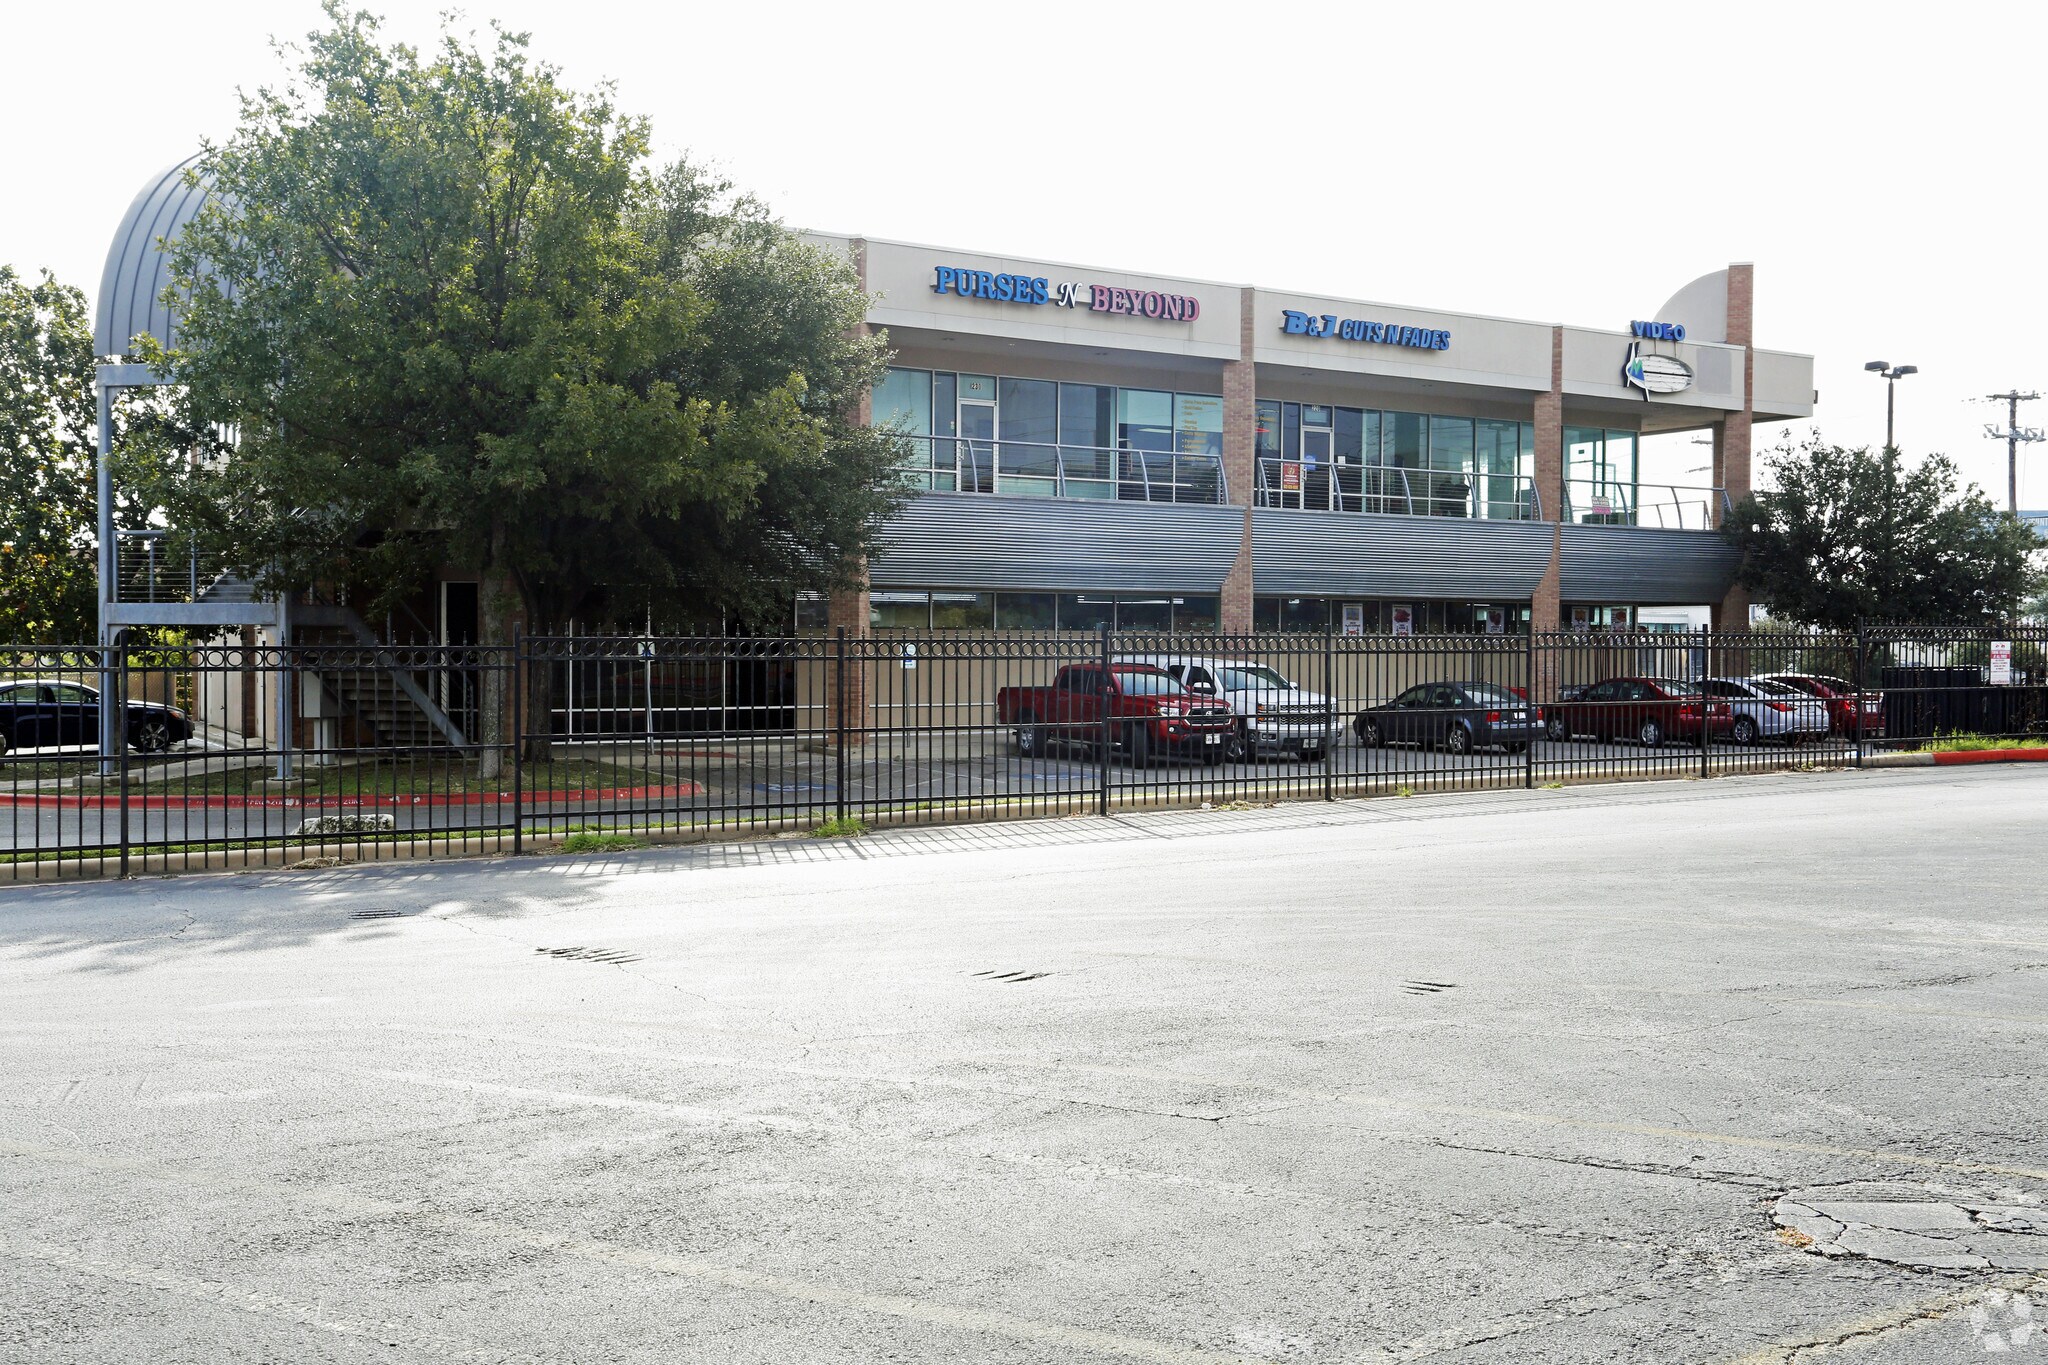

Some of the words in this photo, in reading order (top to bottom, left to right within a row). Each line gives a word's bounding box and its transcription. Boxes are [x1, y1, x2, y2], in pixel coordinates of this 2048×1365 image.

[935, 266, 1049, 305] PURSES
[1056, 281, 1084, 308] N
[1089, 284, 1200, 322] BEYOND
[1281, 309, 1337, 339] B&J
[1340, 318, 1385, 344] CUTS
[1385, 323, 1401, 346] N
[1400, 324, 1450, 351] FADES
[1631, 320, 1685, 341] VIDEO
